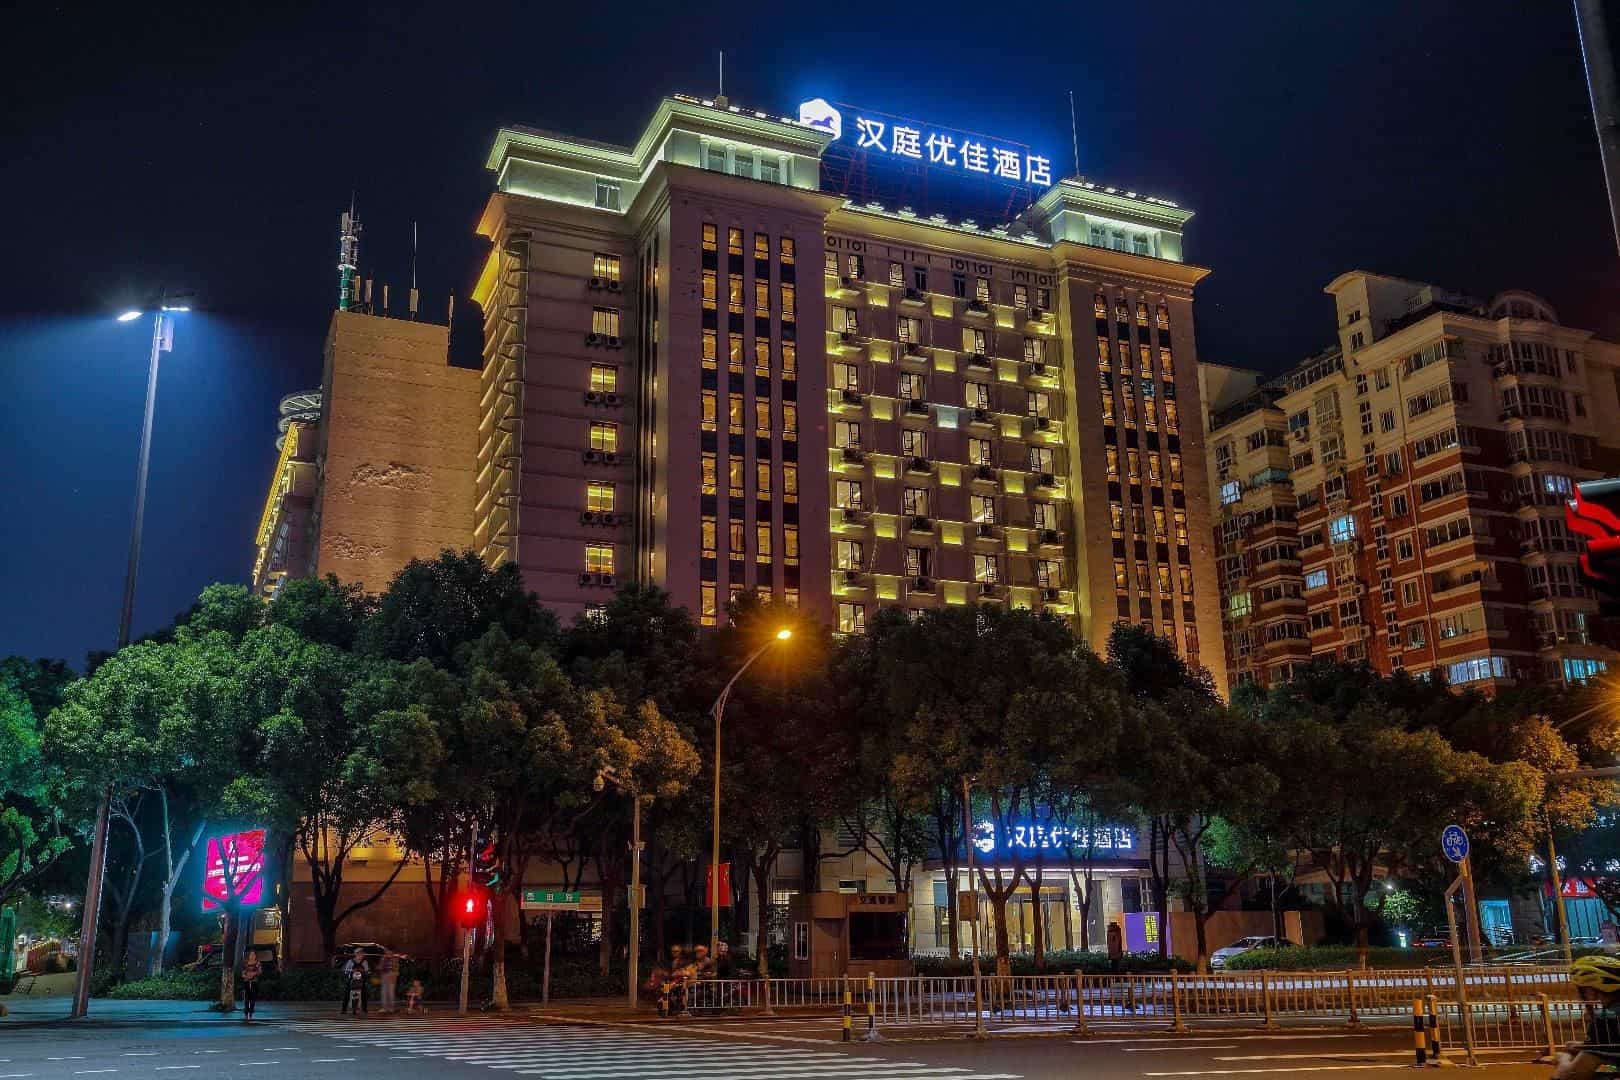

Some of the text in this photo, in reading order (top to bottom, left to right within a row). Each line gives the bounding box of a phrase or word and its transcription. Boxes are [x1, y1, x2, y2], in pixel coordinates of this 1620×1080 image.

[856, 116, 1051, 187] 汉庭优佳酒店
